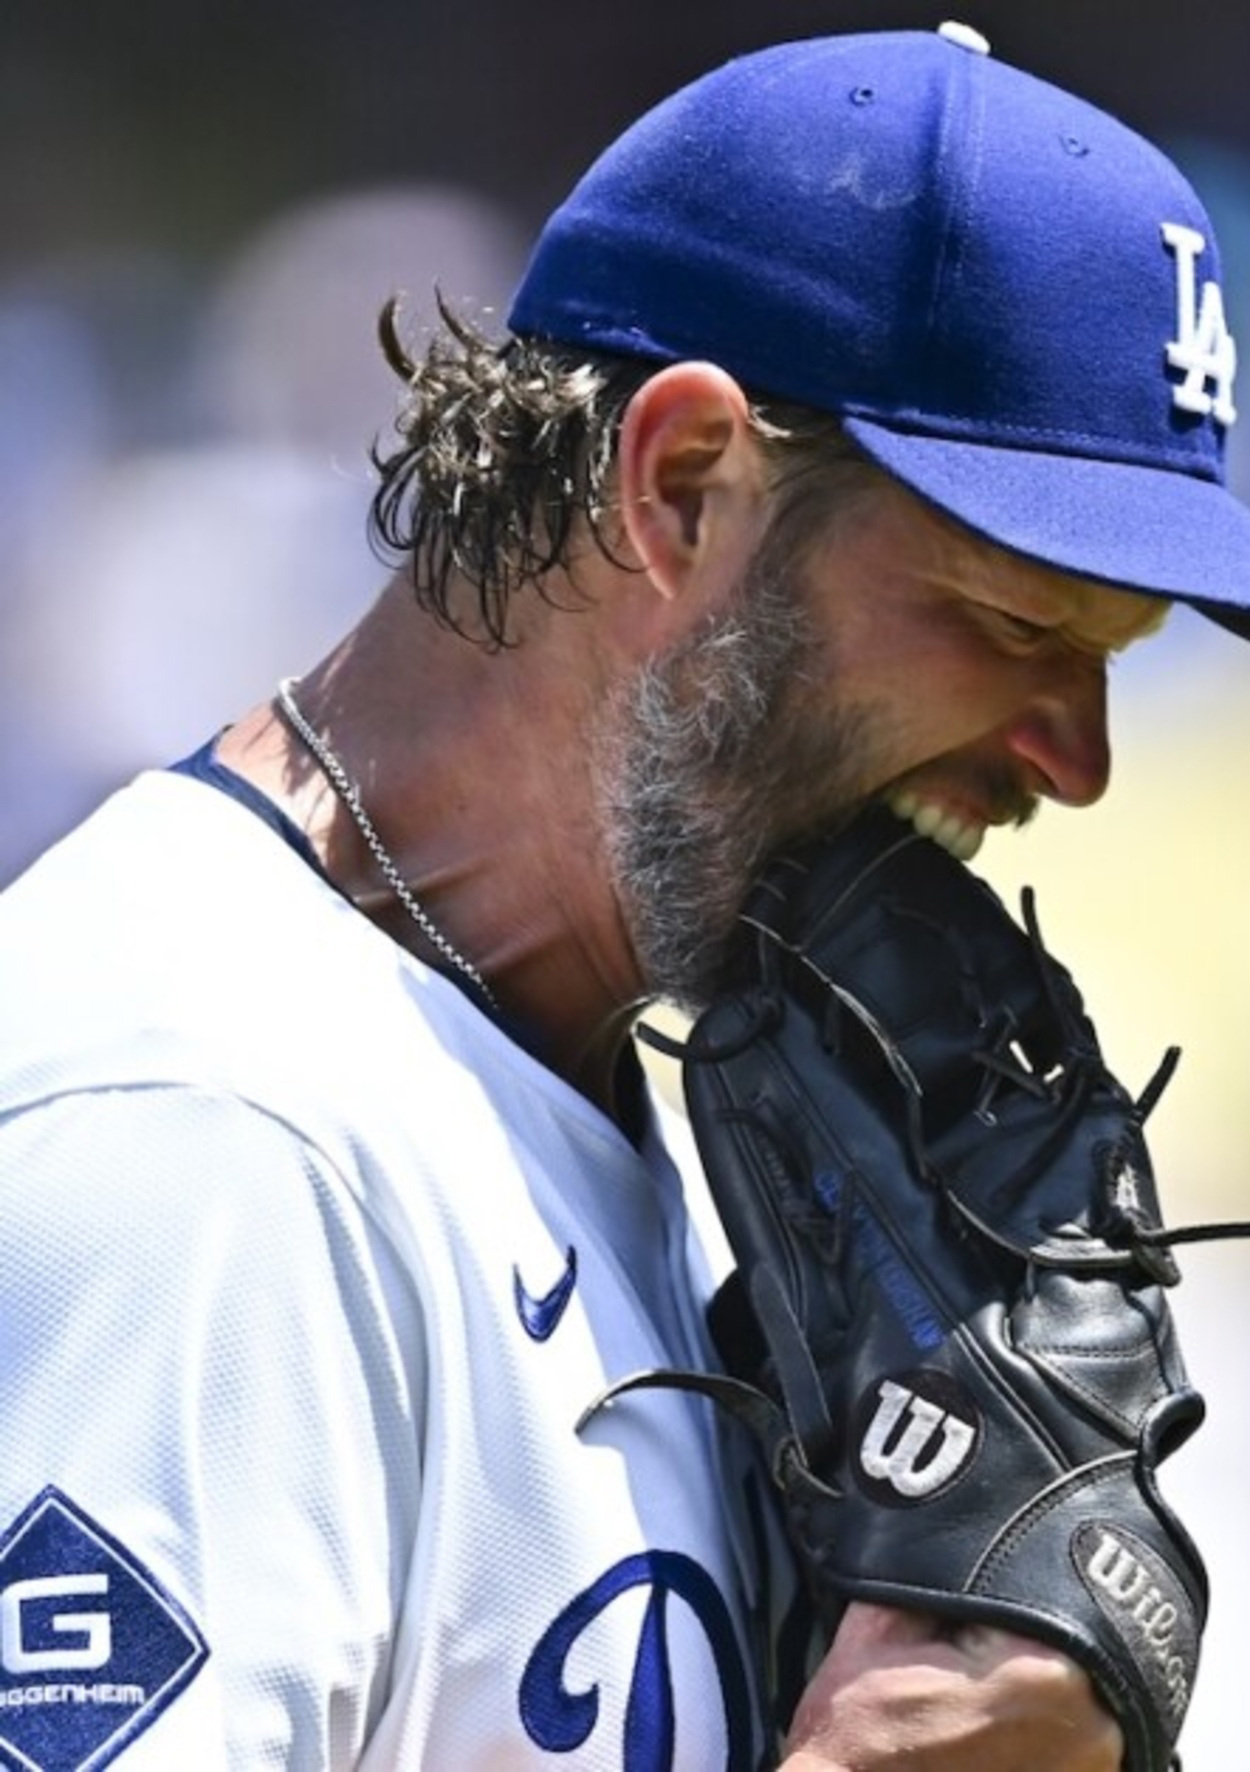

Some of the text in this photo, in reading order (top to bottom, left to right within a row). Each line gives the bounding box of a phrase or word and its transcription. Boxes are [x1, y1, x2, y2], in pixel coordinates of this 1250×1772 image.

[1160, 222, 1237, 425] LA
[860, 1380, 976, 1496] W
[0, 1574, 112, 1674] G
